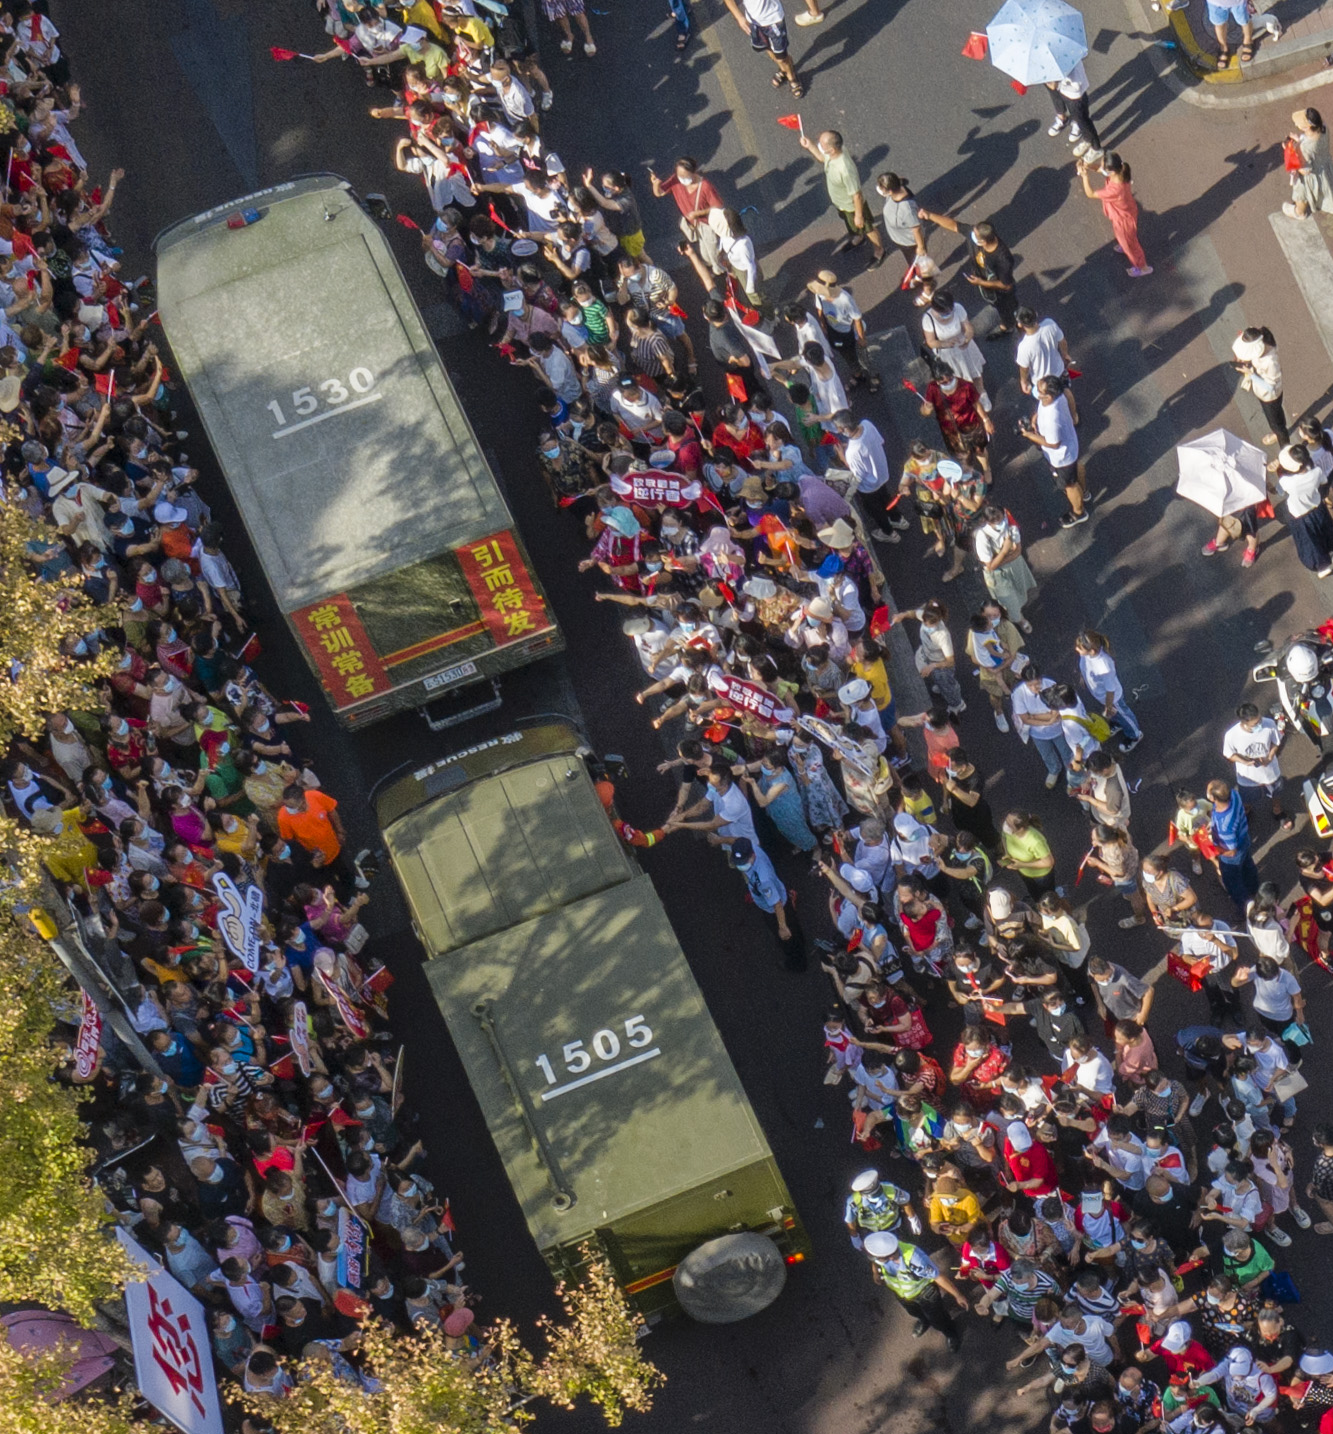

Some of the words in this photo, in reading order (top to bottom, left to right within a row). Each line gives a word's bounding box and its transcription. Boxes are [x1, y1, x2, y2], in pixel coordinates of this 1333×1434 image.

[267, 367, 374, 425] 1530
[633, 488, 680, 502] 逆行者
[471, 540, 536, 637] 引而待发
[307, 604, 375, 698] 常训常备
[728, 690, 773, 718] 逆行者
[435, 738, 499, 768] RESCUE
[247, 939, 256, 969] COME
[536, 1014, 653, 1085] 1505
[147, 1281, 206, 1419] 您
